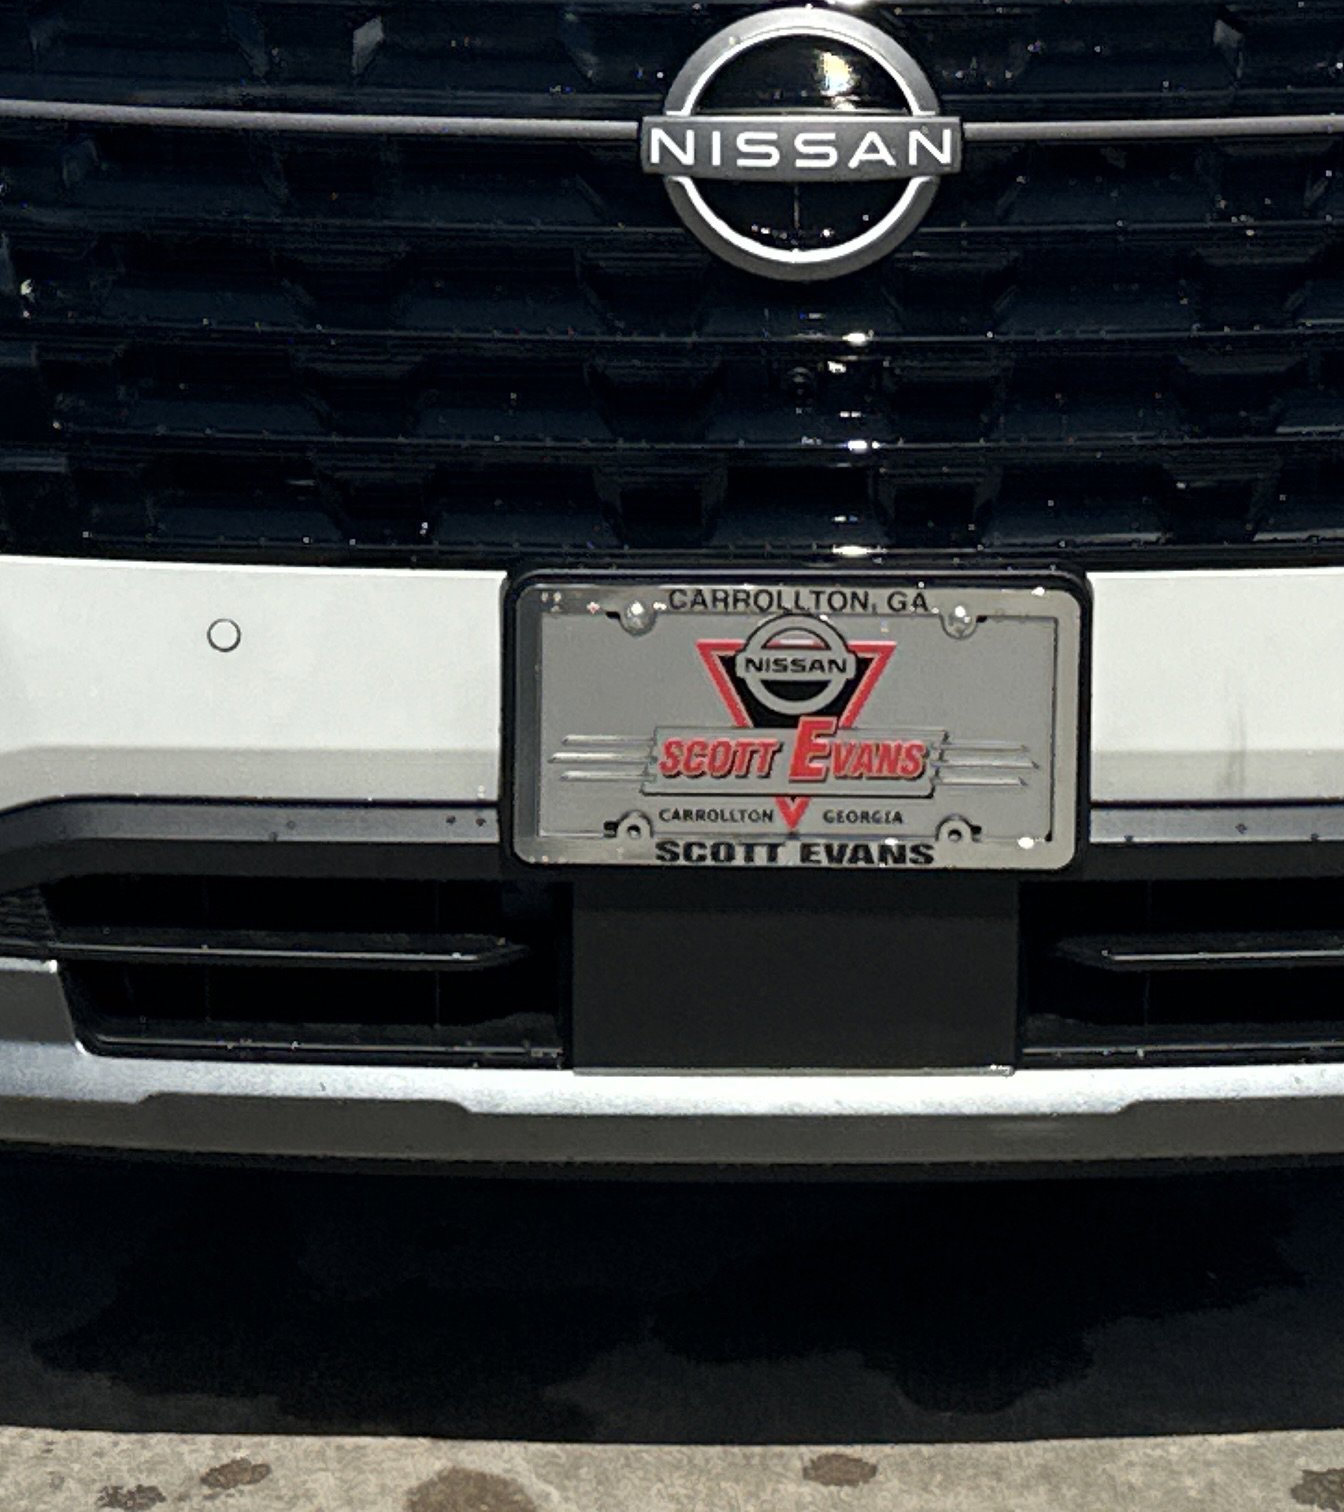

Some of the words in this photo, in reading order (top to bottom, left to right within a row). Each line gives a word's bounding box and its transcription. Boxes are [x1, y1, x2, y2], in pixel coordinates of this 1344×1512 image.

[650, 127, 953, 169] NISSAN
[887, 590, 930, 613] GA
[744, 656, 848, 675] NISSAN
[658, 738, 782, 779] SCOTT
[788, 716, 930, 782] EVANS
[659, 808, 775, 824] CARROLLTON
[822, 810, 905, 826] GEORGIA
[656, 842, 783, 865] SCOTT
[799, 842, 935, 866] EVANS
